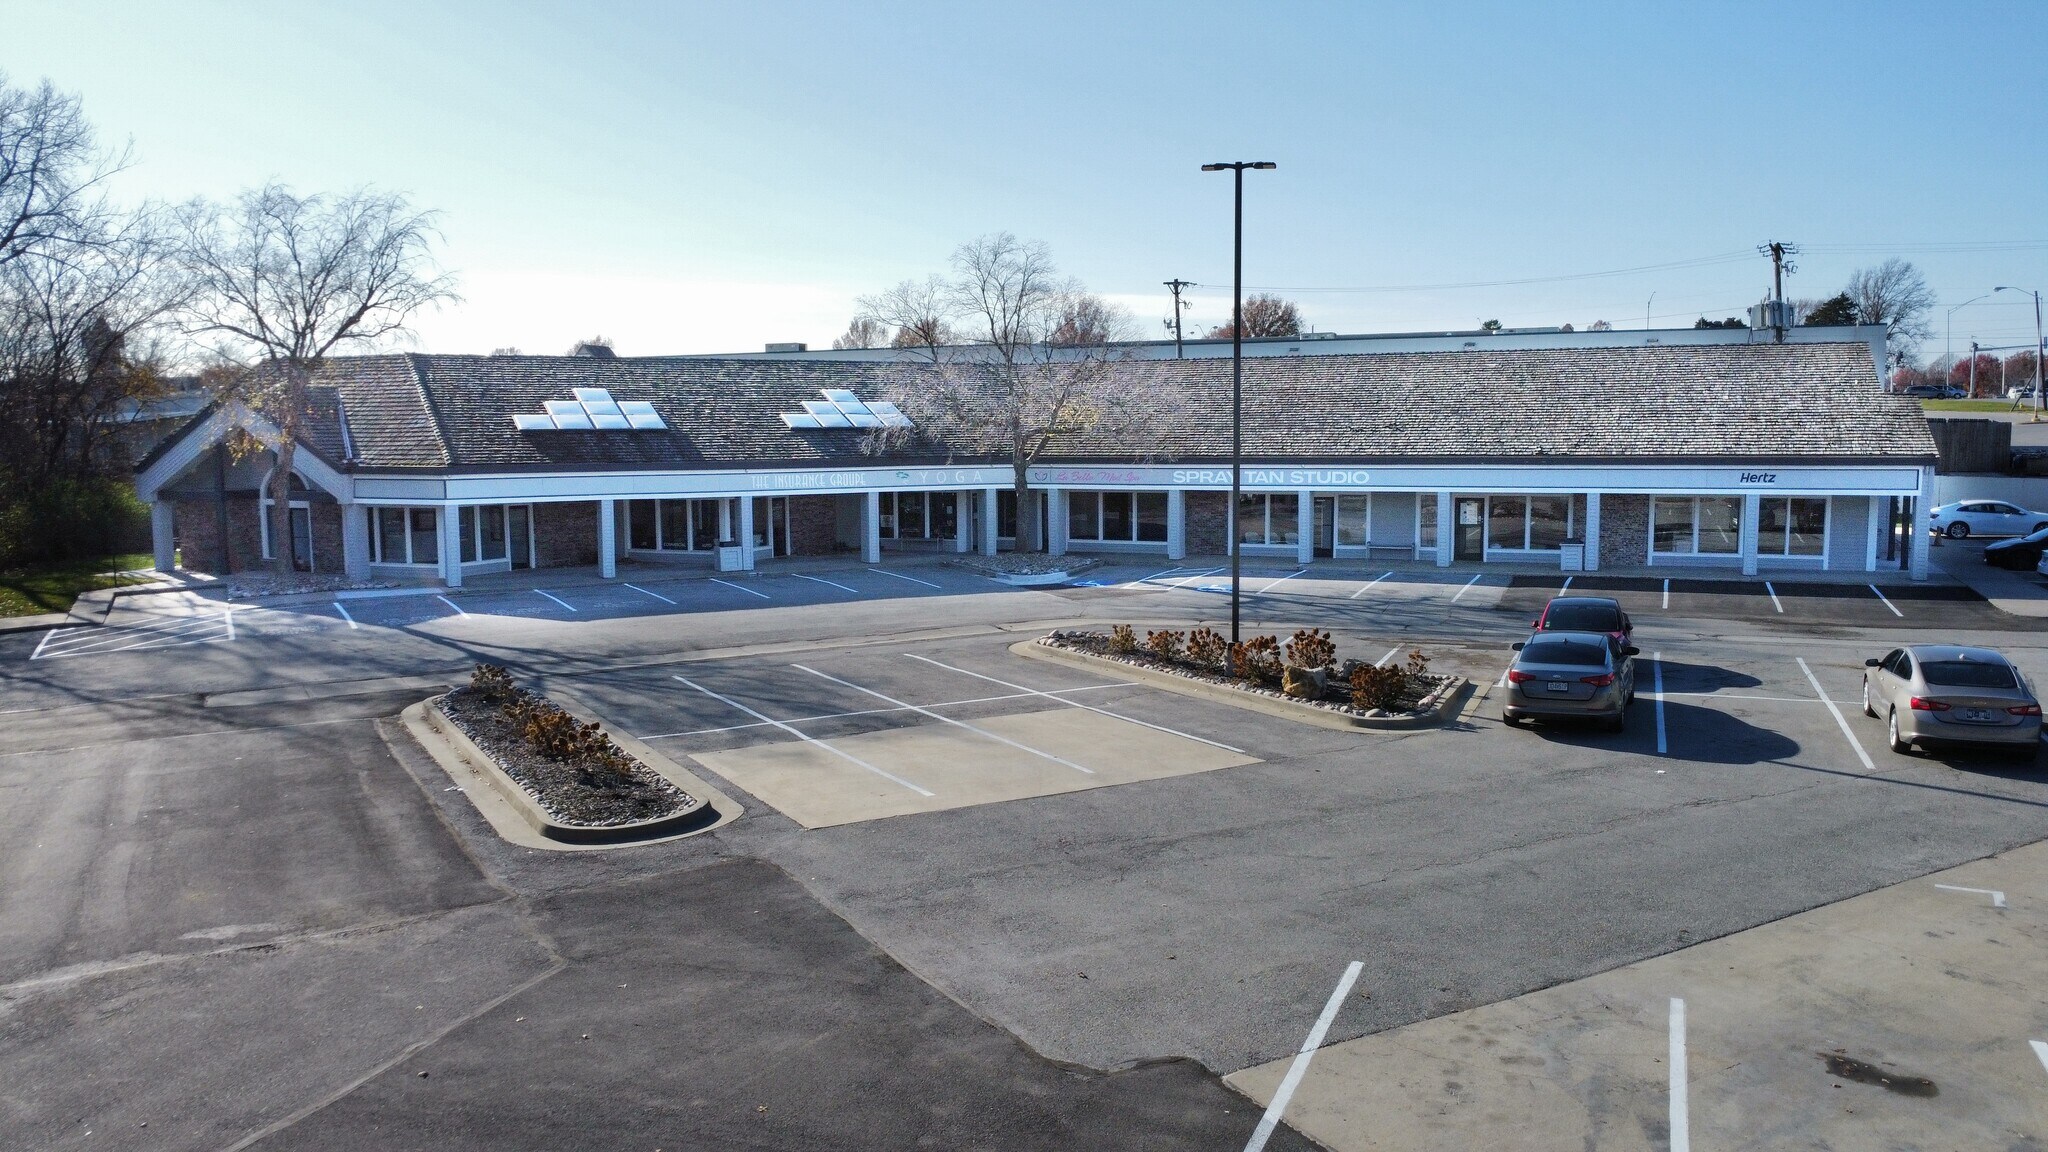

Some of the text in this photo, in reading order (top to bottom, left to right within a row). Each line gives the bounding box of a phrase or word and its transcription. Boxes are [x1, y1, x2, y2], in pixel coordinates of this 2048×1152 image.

[752, 472, 866, 489] THE INSURANCE GROUPE
[920, 471, 982, 484] YOGA
[1244, 471, 1284, 484] TAN
[1290, 471, 1370, 484] STUDIO
[1740, 472, 1777, 483] Hertz
